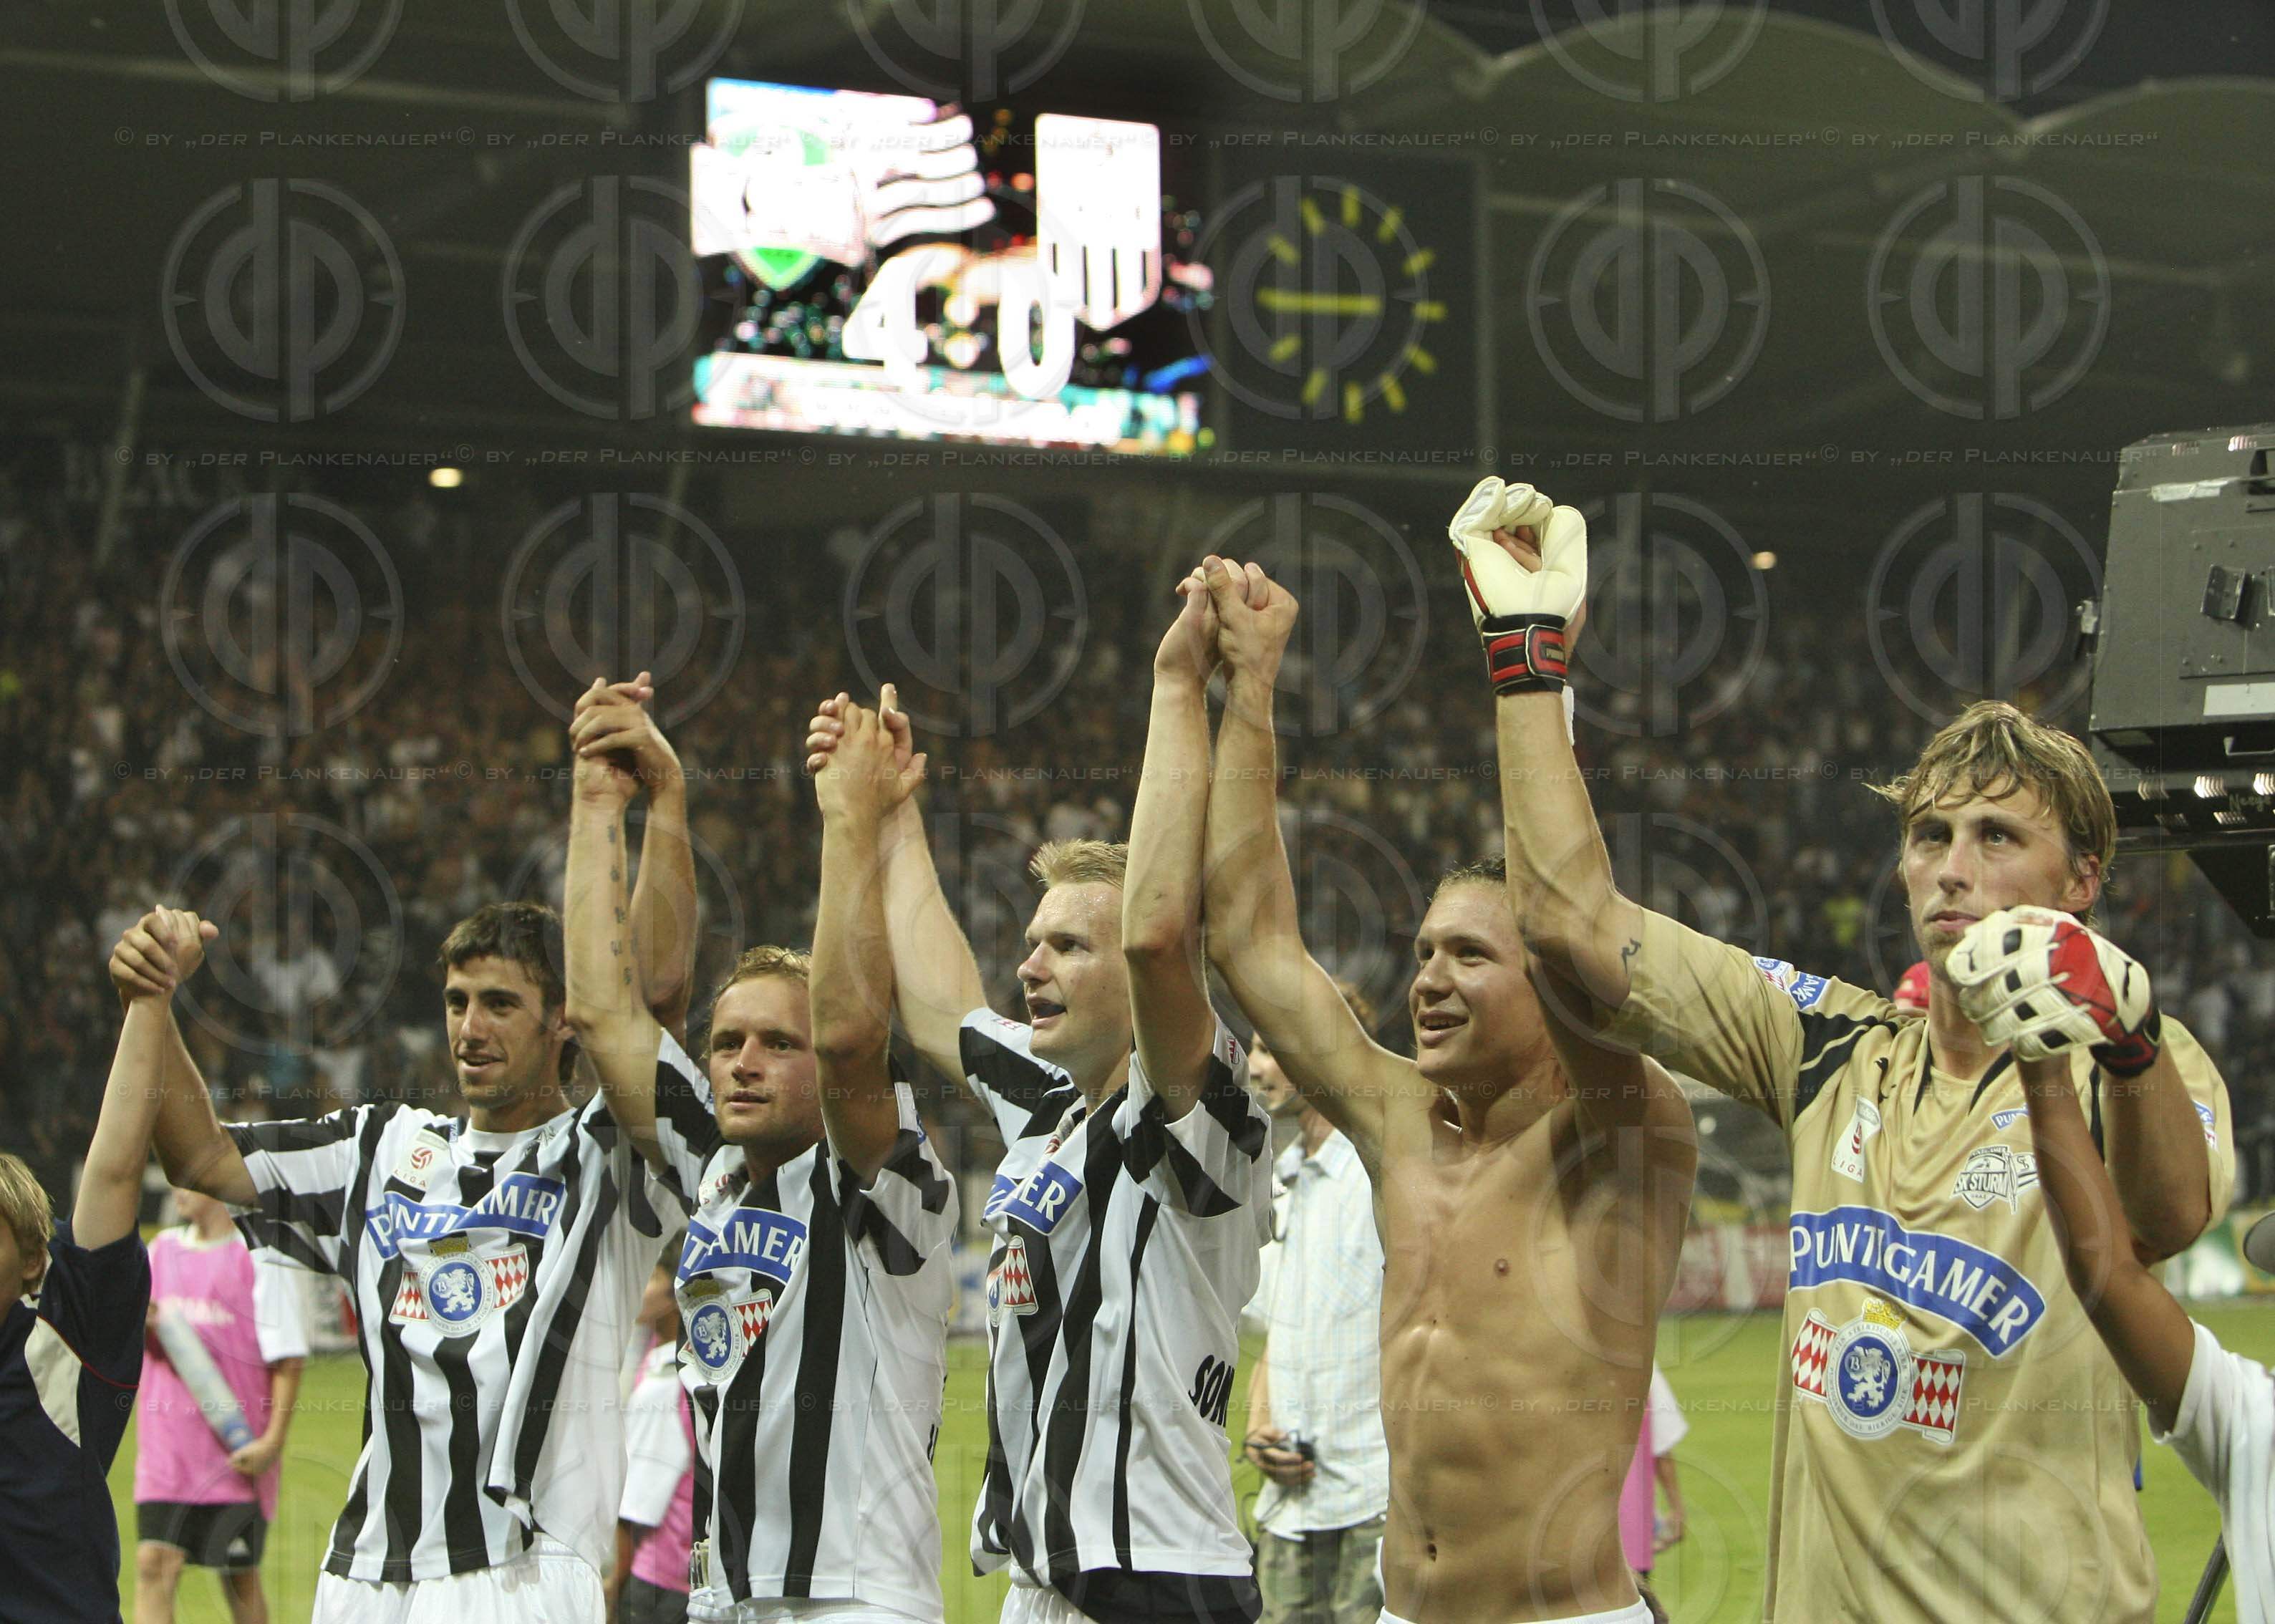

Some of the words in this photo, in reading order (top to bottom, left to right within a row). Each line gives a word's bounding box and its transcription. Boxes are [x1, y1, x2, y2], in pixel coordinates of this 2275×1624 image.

[395, 1169, 427, 1188] LIGA
[1969, 1173, 2009, 1197] STURM
[1789, 1222, 2030, 1345] PUNTIGAMER
